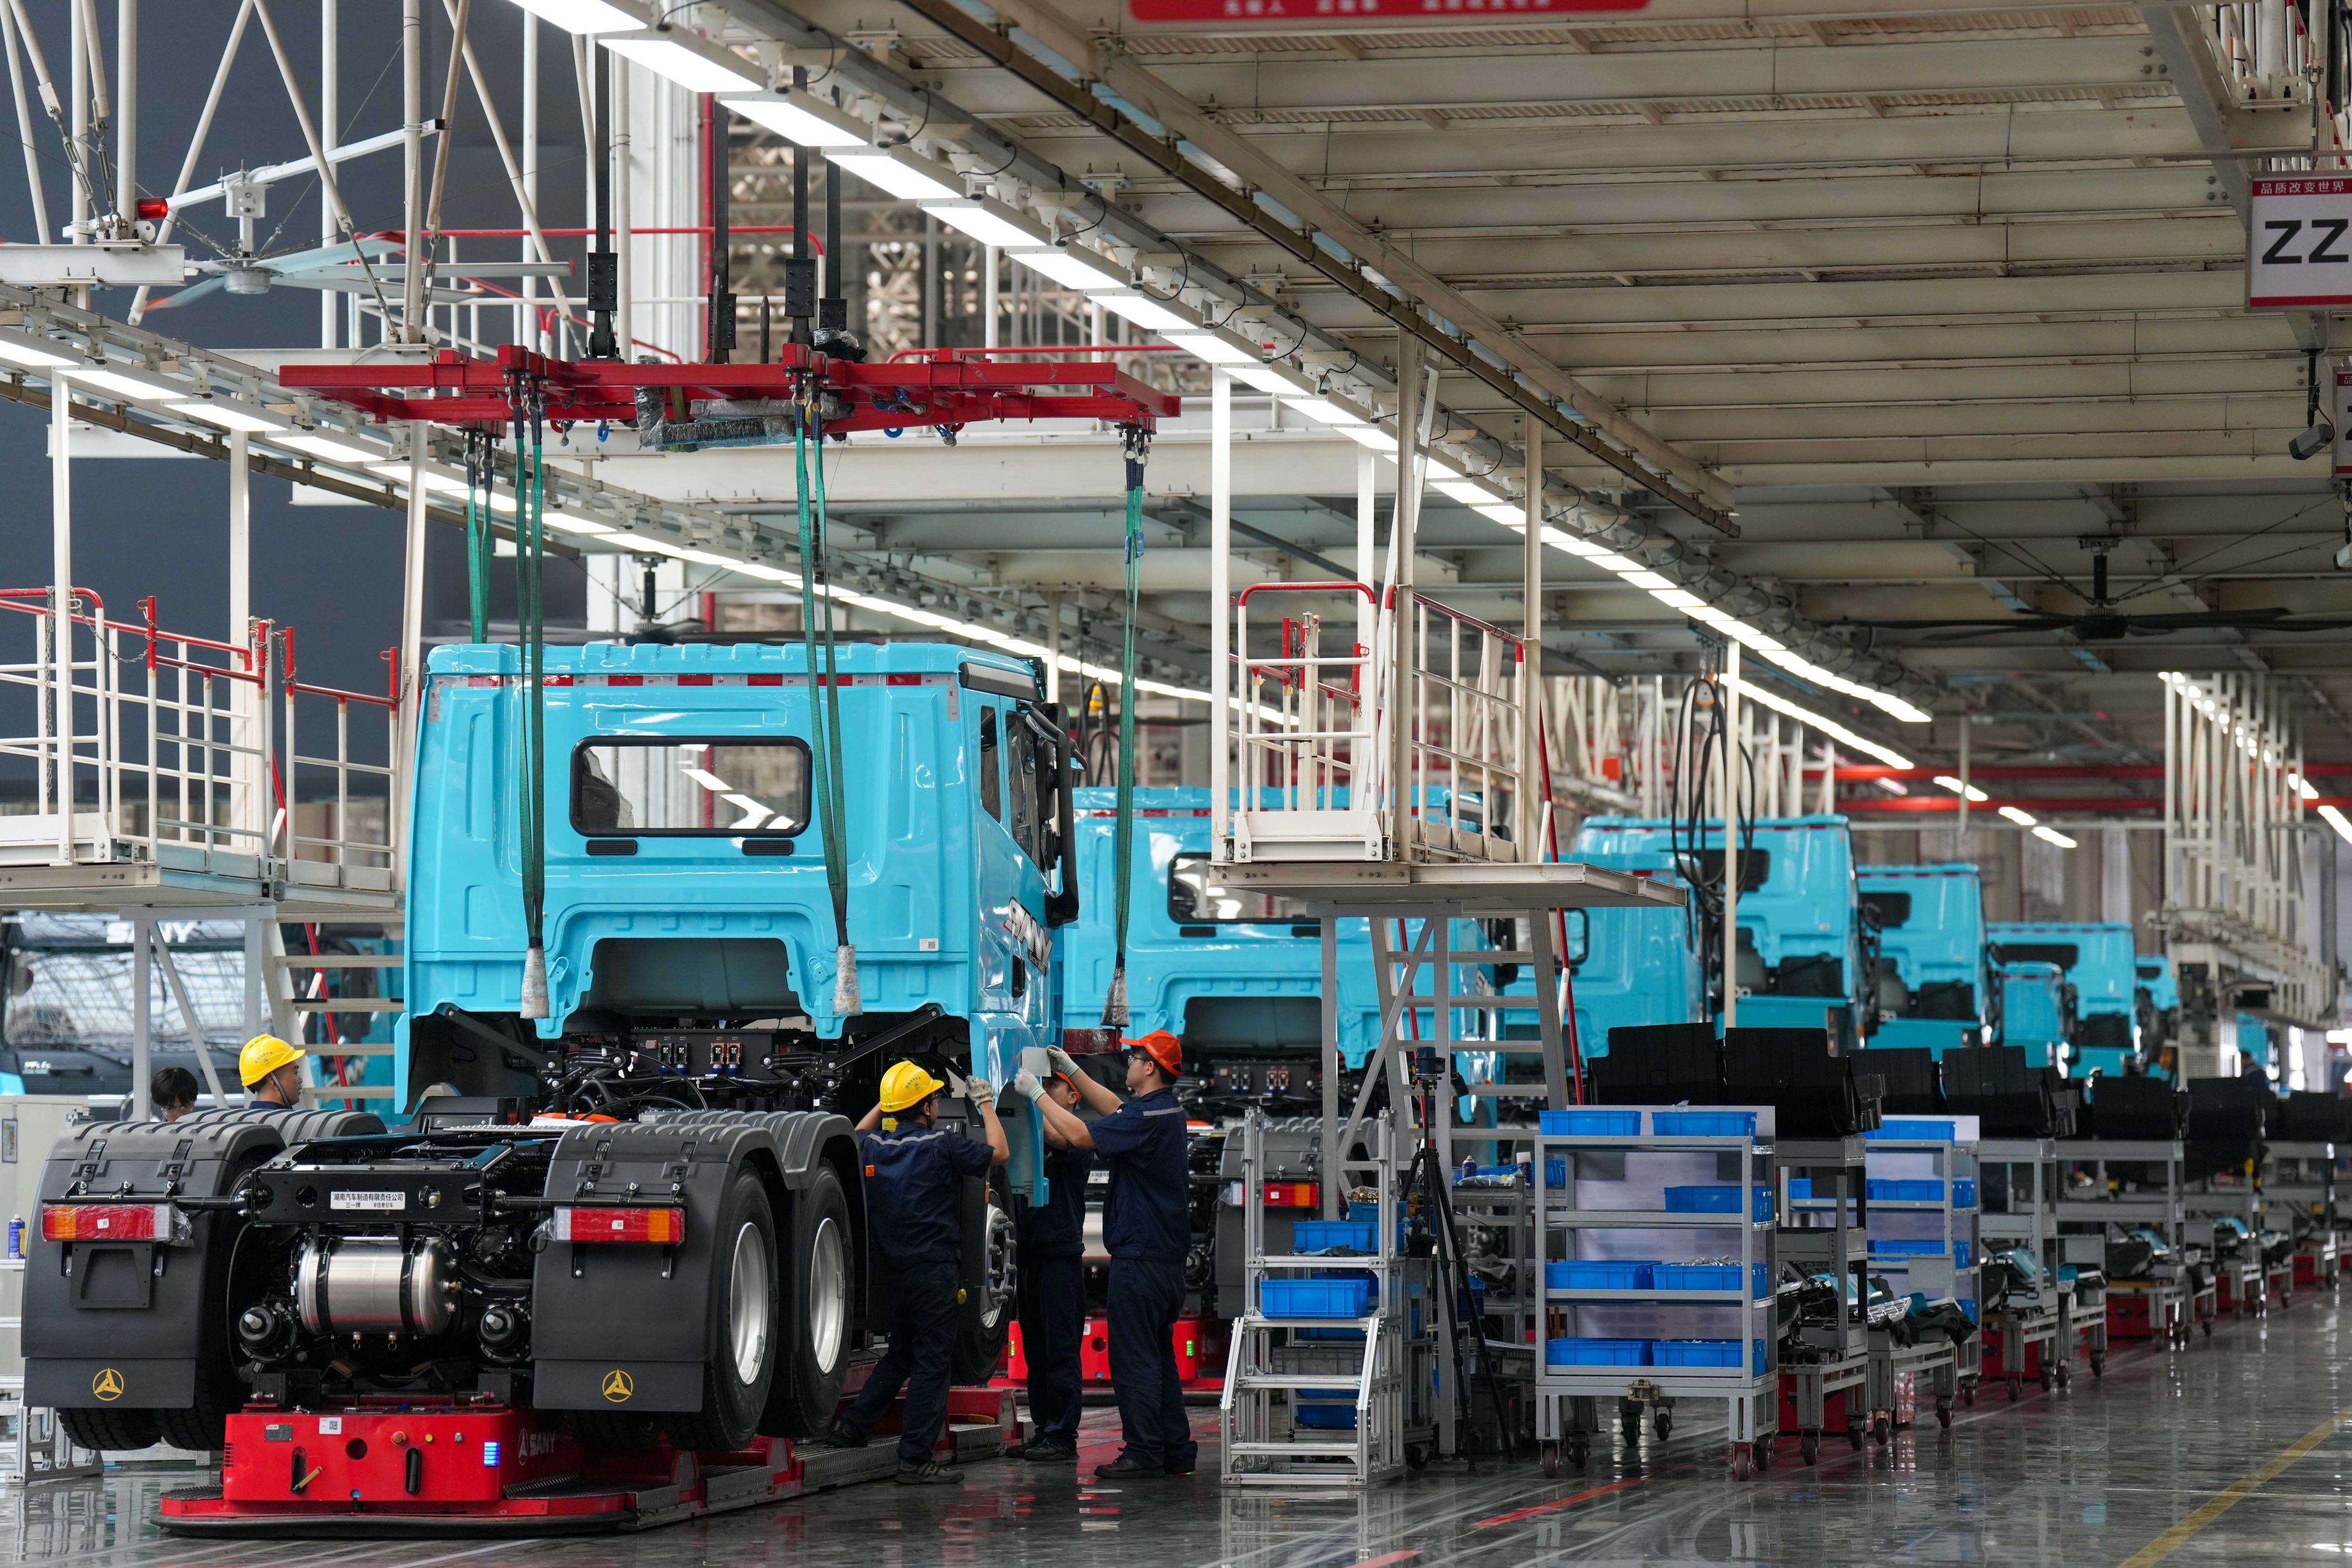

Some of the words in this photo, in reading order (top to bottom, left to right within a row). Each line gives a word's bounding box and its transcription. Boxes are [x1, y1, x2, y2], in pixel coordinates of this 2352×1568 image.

[2261, 181, 2344, 194] 品质改变世界
[2262, 219, 2349, 264] ZZ
[106, 921, 195, 944] SNY
[1003, 896, 1053, 966] SANY
[334, 1194, 403, 1202] 湖南汽车制造有限责任公司
[530, 1430, 556, 1456] SANY
